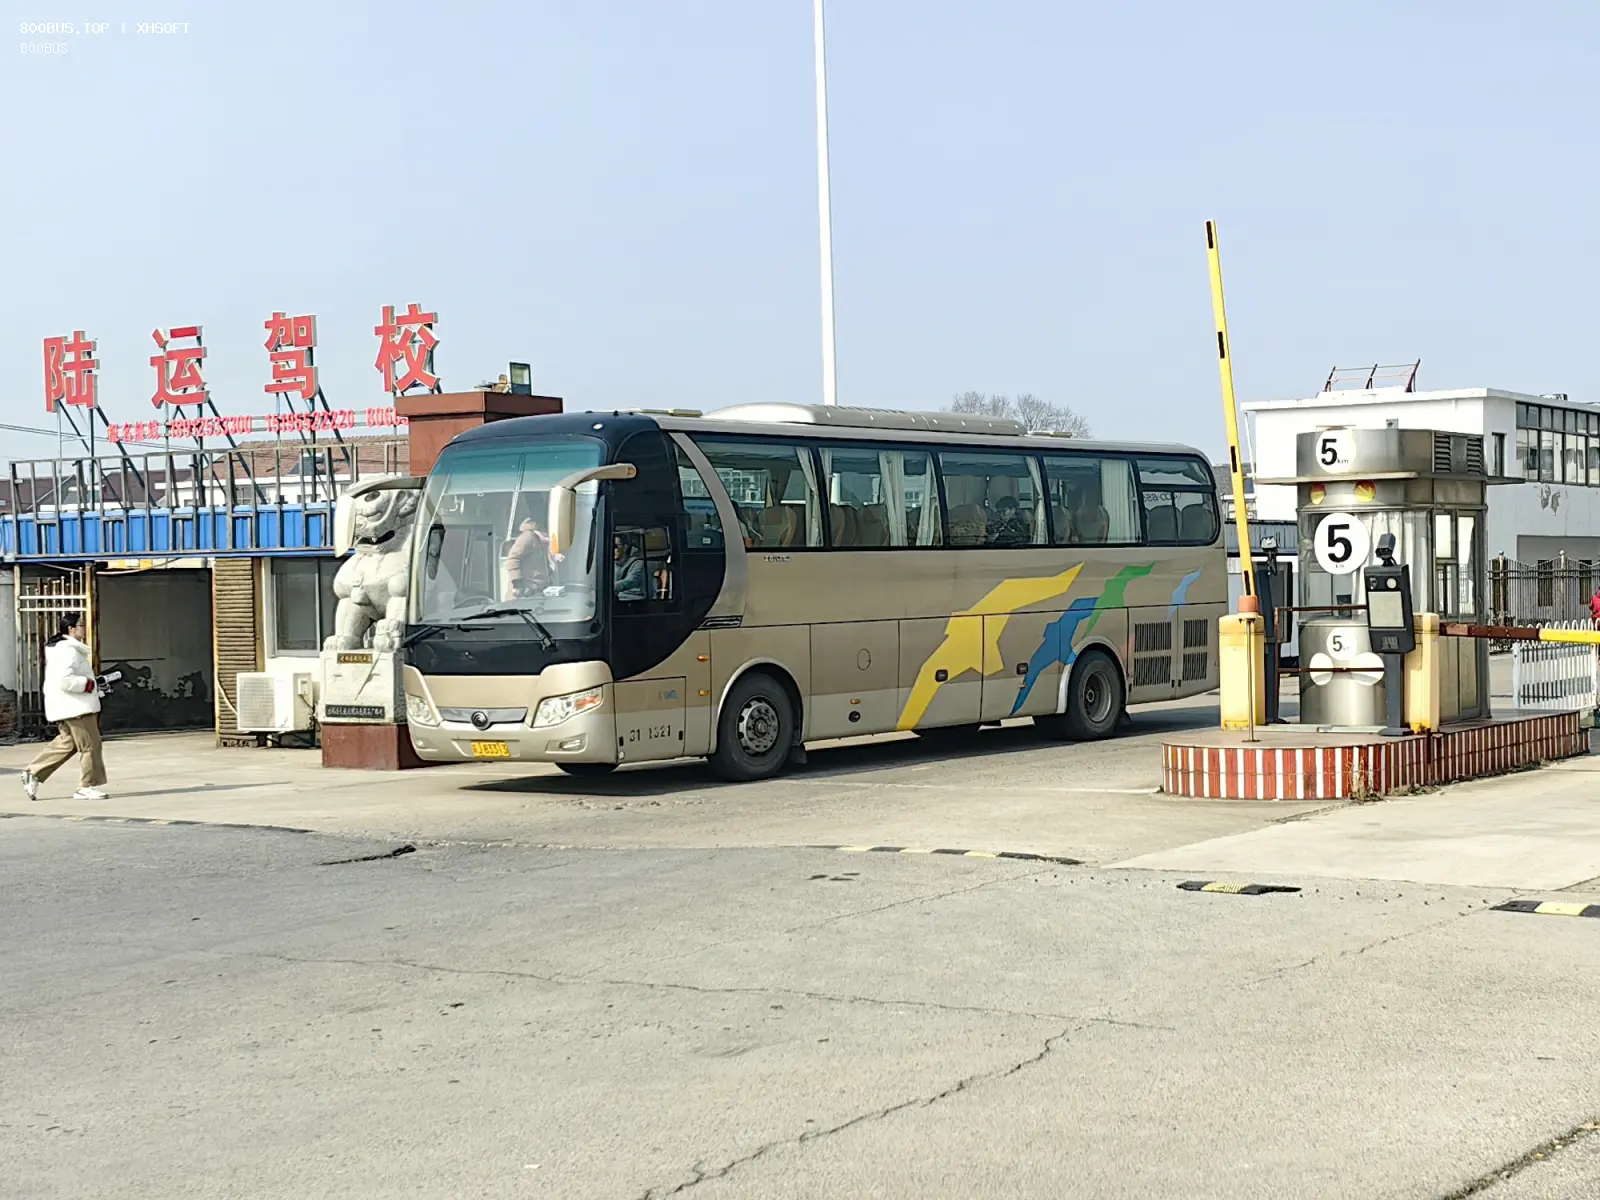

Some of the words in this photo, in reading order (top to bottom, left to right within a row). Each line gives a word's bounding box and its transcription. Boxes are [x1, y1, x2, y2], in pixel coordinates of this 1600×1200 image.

[43, 303, 438, 413] 陆运驾校
[1321, 438, 1338, 466] 5
[1327, 523, 1353, 563] 5
[1332, 635, 1343, 652] 5
